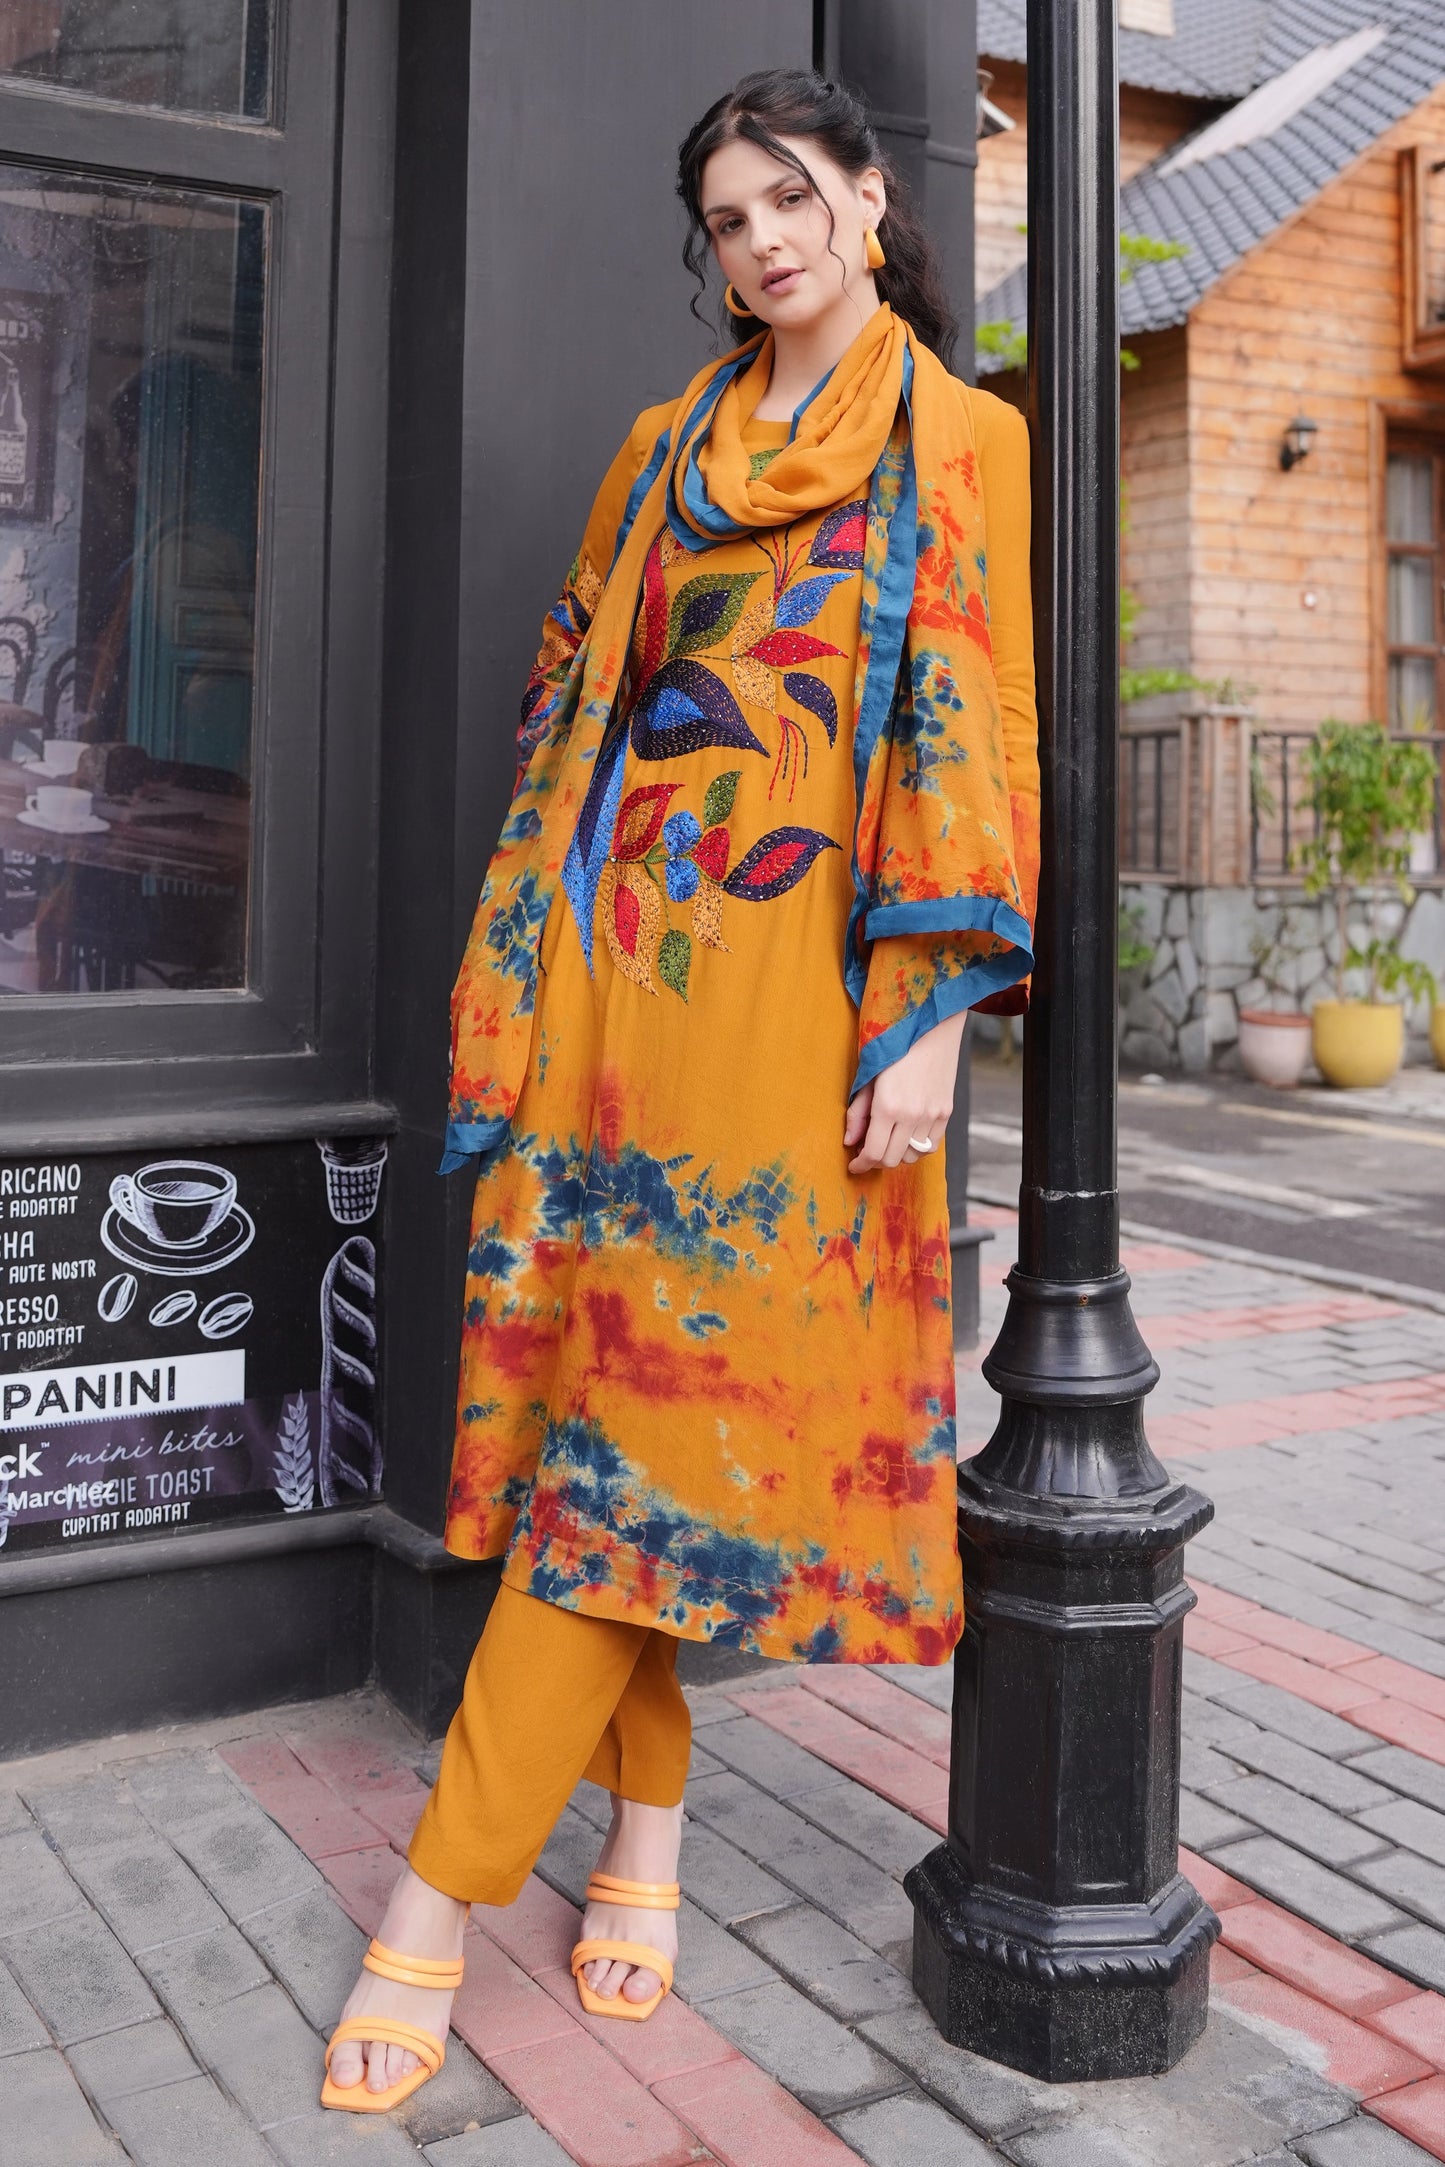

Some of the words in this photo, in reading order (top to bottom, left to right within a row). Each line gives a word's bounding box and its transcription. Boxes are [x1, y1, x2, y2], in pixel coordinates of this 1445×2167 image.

[1, 1163, 81, 1196] RICANO
[9, 1196, 79, 1219] ADDATAT
[0, 1230, 34, 1260] HA
[9, 1263, 46, 1285] AUTE
[52, 1258, 97, 1281] NOSTR
[16, 1325, 86, 1350] ADDATAT
[3, 1365, 176, 1421] PANINI
[66, 1437, 154, 1468] mini
[158, 1424, 245, 1455] bites
[145, 1466, 215, 1500] TOAST
[62, 1511, 121, 1538] CUPITAT
[125, 1501, 192, 1529] ADDATAT
